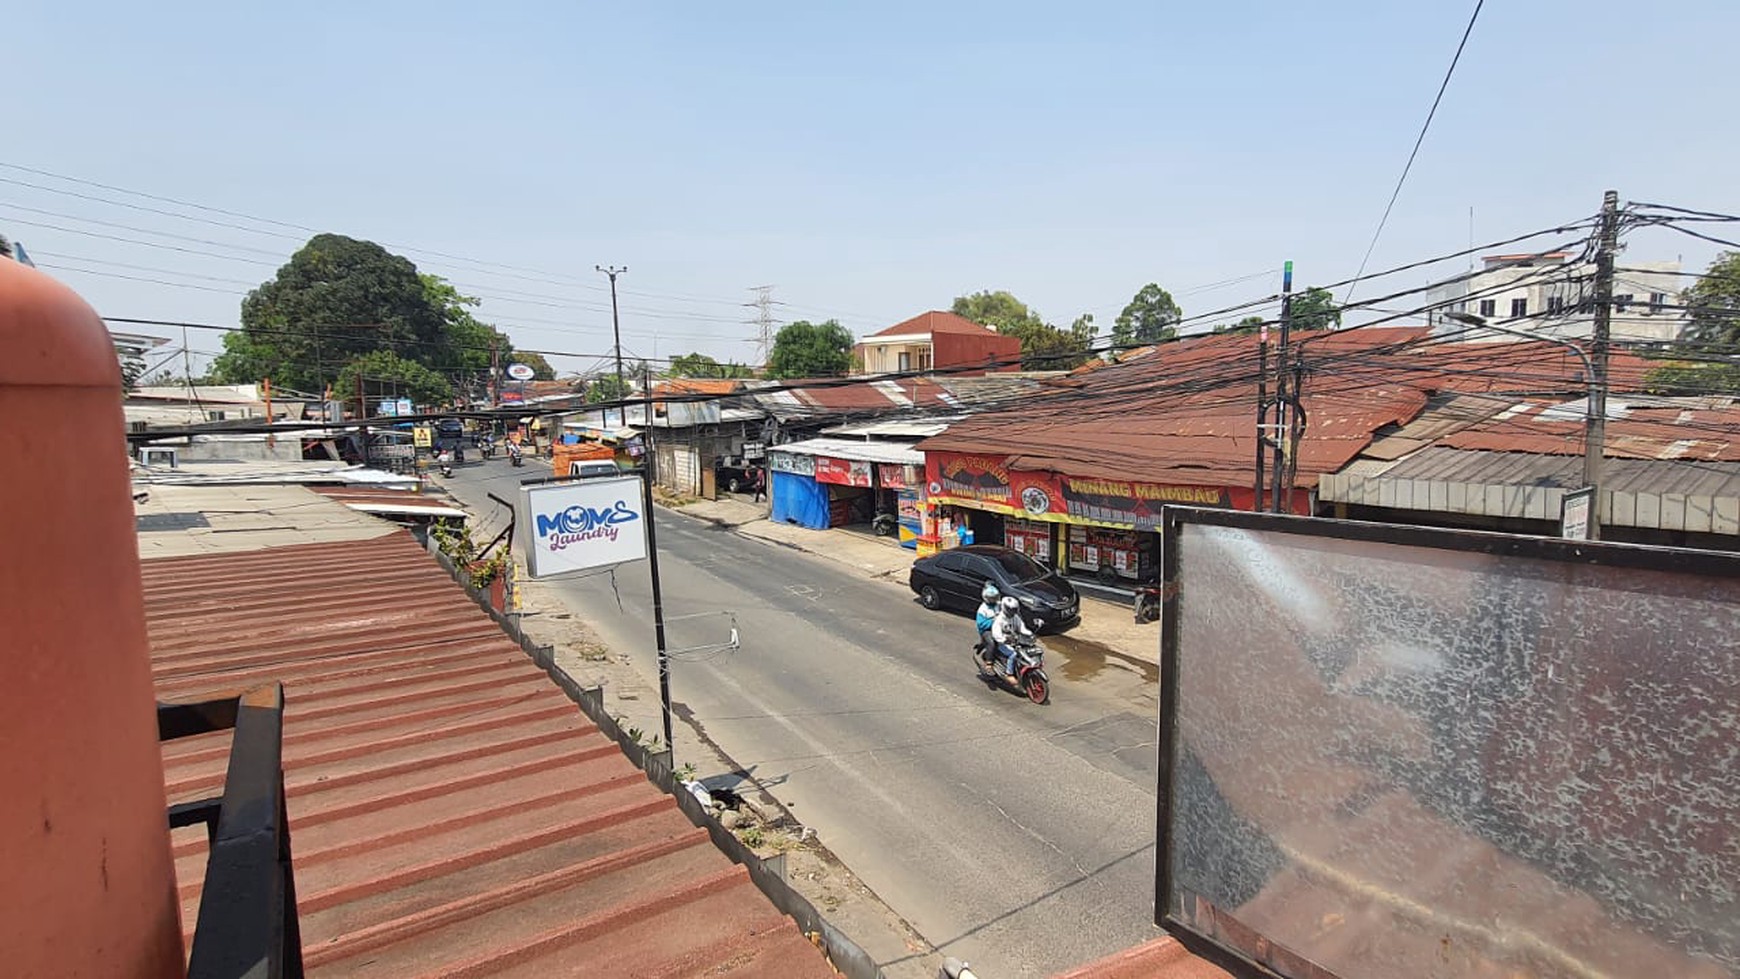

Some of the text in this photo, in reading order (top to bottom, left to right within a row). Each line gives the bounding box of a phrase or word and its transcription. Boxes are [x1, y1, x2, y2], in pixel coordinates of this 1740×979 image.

[1069, 478, 1132, 498] MINANG
[536, 500, 639, 538] MOMS
[550, 527, 619, 551] Laundry
